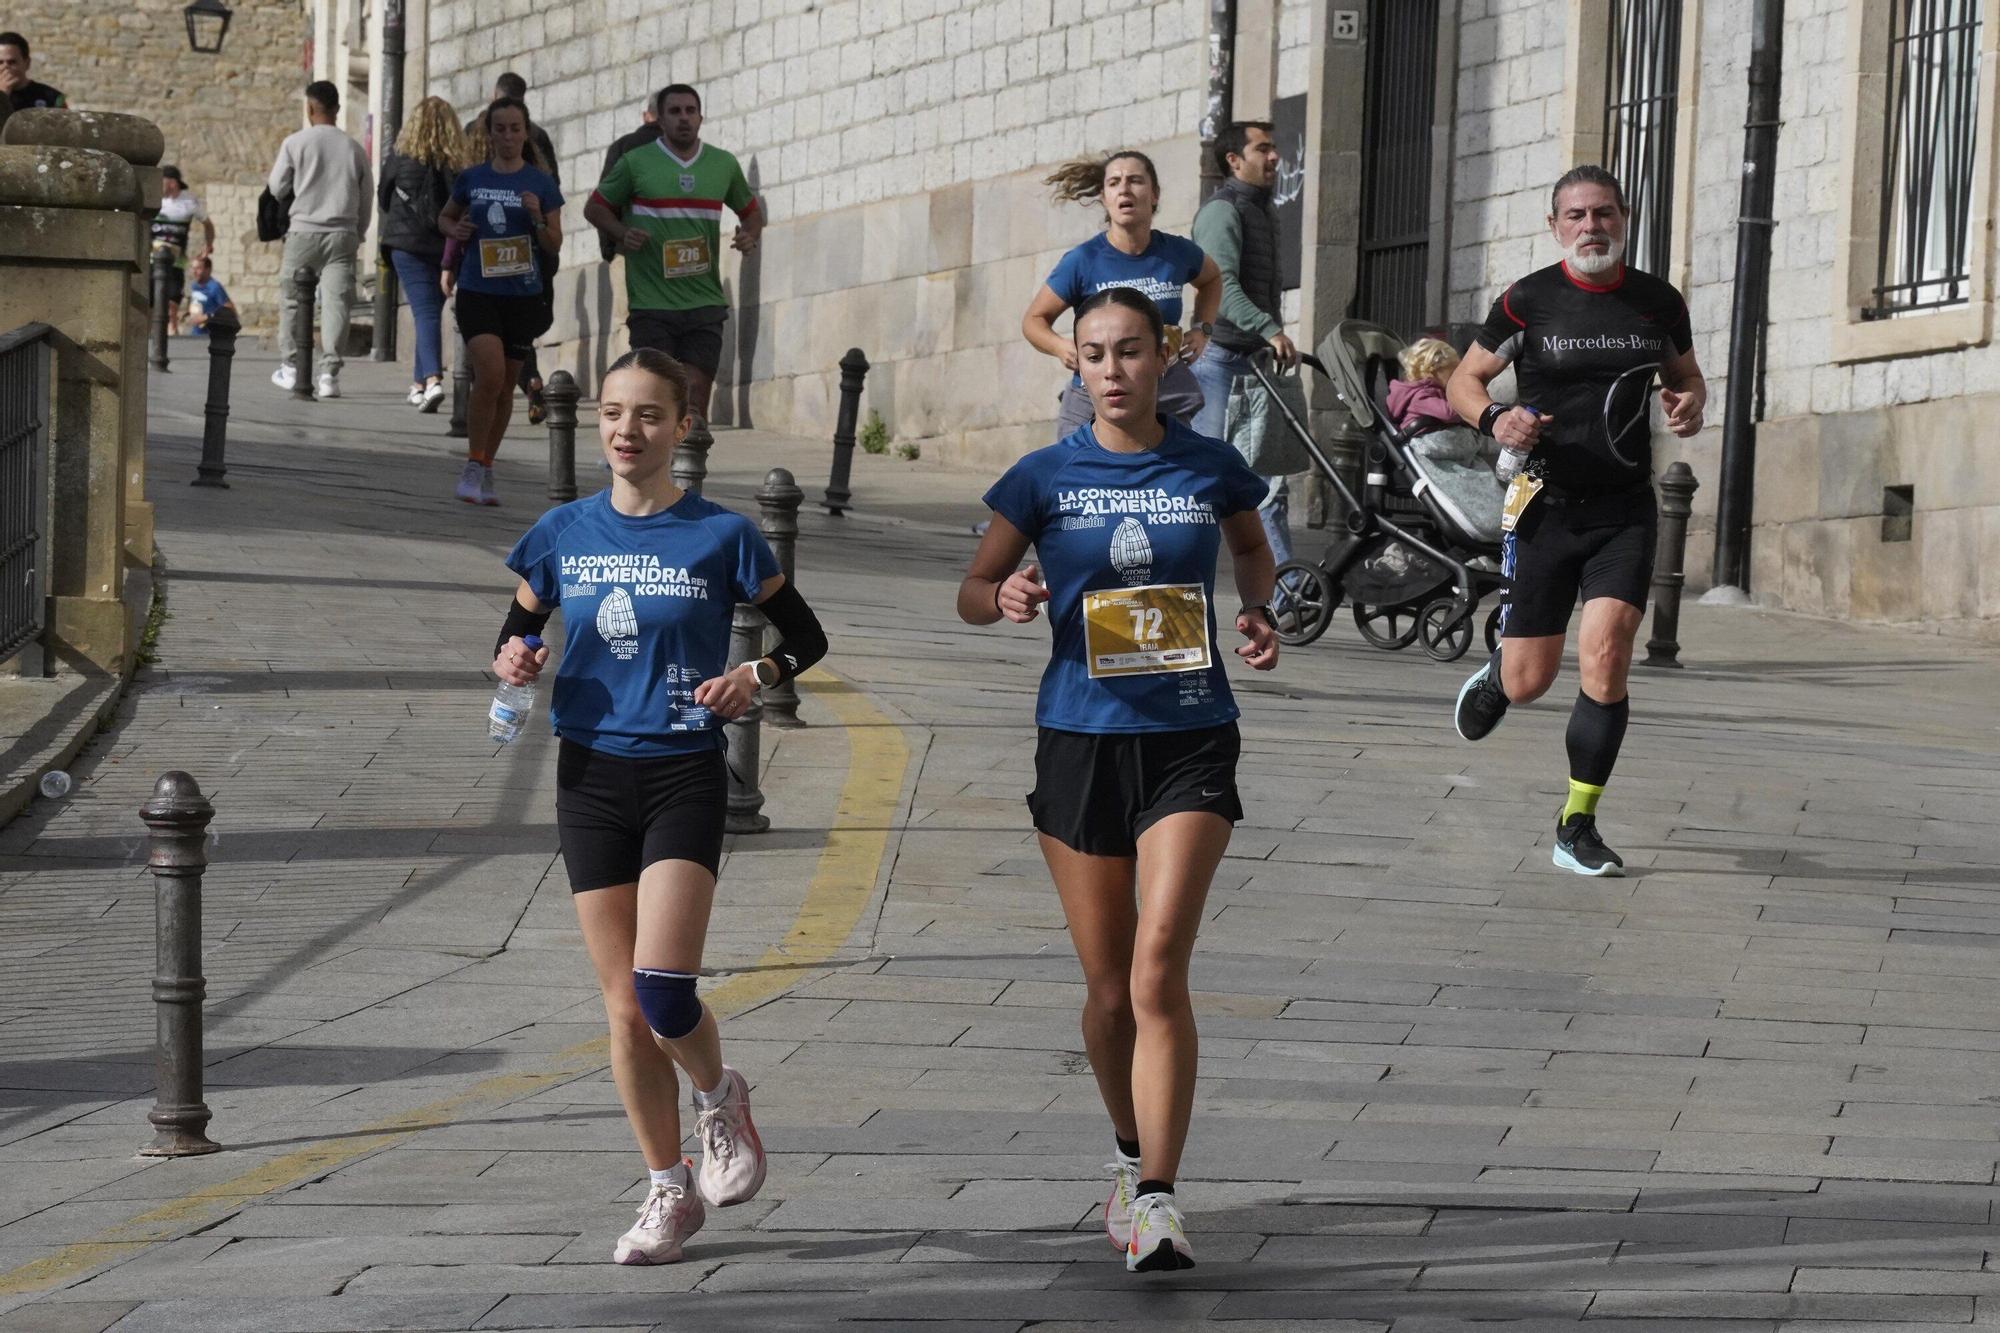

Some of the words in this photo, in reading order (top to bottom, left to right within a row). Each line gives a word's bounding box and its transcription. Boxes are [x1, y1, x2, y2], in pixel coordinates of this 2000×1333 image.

[1339, 14, 1353, 35] 5
[496, 246, 517, 262] 277
[678, 247, 700, 263] 276
[1096, 282, 1107, 292] LA
[1542, 334, 1662, 351] Mercedes-Benz
[1058, 491, 1077, 504] LA
[1078, 488, 1167, 500] CONQUISTA
[1060, 503, 1071, 511] DE
[1072, 501, 1084, 509] LA
[1082, 495, 1201, 515] ALMENDRA
[1148, 511, 1216, 525] KONKISTA
[561, 555, 577, 567] LA
[578, 554, 660, 568] CONQUISTA
[578, 567, 690, 584] ALMENDRA
[691, 577, 708, 587] REN
[1122, 568, 1151, 576] VITORIA
[635, 583, 708, 601] KONKISTA
[1130, 608, 1164, 640] 72
